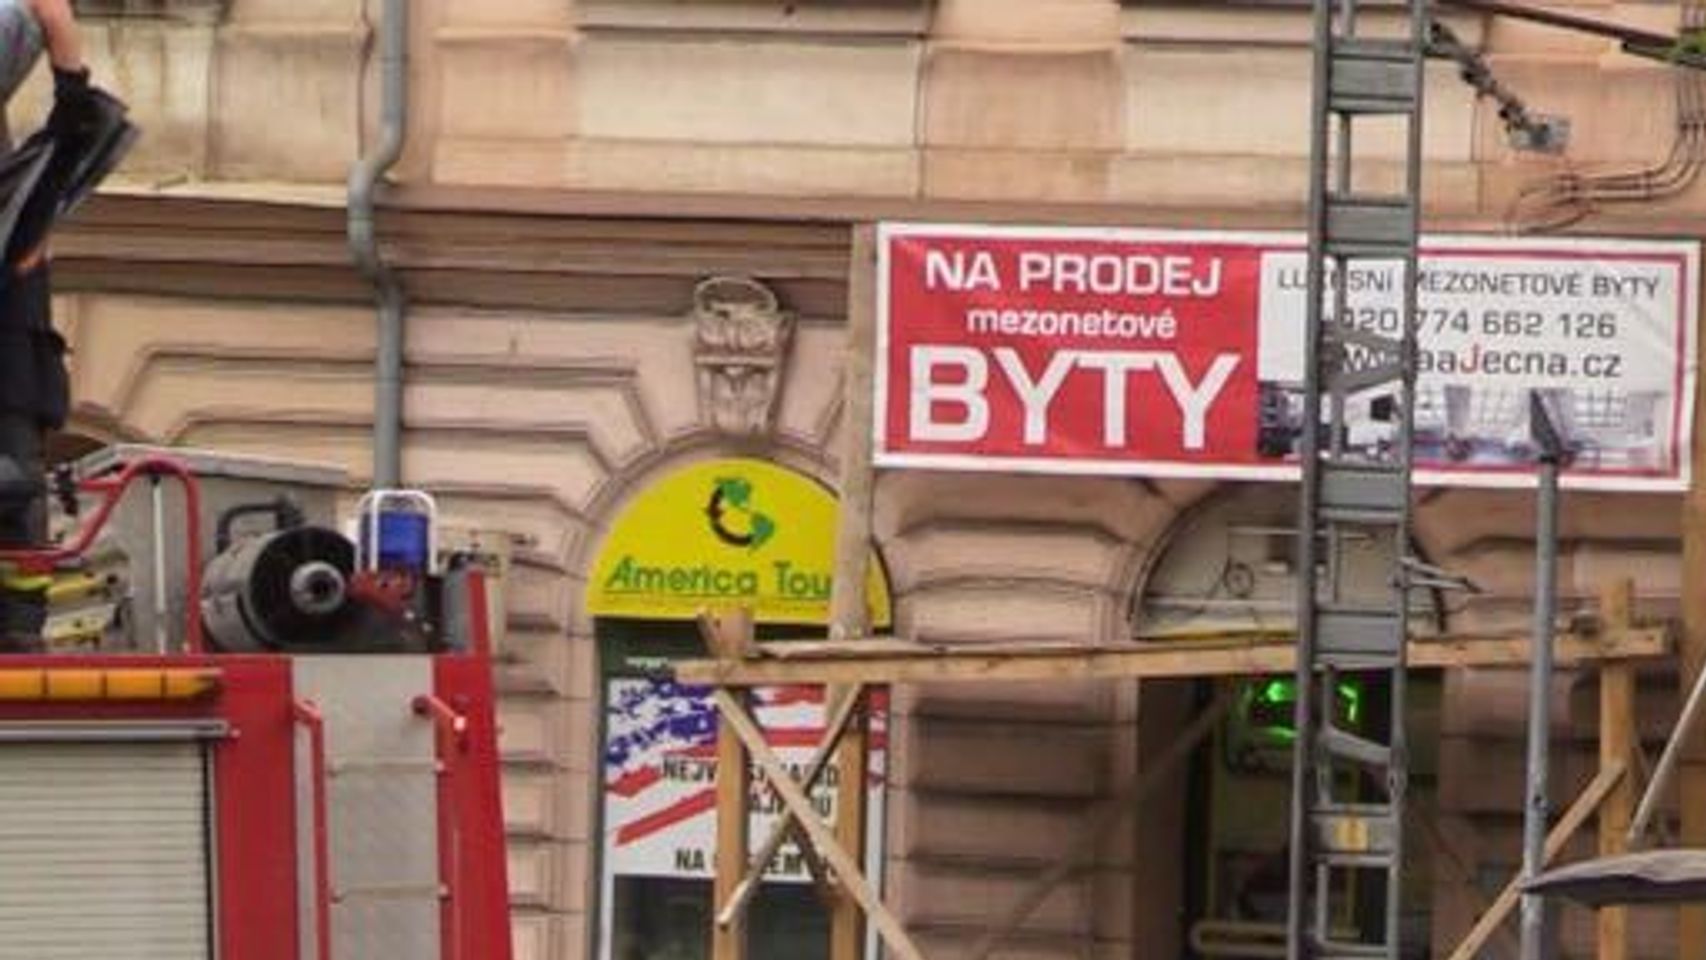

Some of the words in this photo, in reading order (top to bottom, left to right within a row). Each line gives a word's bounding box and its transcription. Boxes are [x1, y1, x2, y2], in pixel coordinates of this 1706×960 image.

[925, 251, 1000, 292] NA
[1018, 253, 1221, 298] PRODEJ
[1592, 275, 1660, 299] BYTY
[967, 304, 1176, 340] mezonetové
[1414, 309, 1470, 334] 774
[1482, 311, 1543, 337] 662
[1559, 312, 1618, 338] 126
[907, 343, 1240, 450] BYTY
[604, 555, 758, 597] America
[773, 559, 834, 598] Tou
[675, 849, 705, 871] NA
